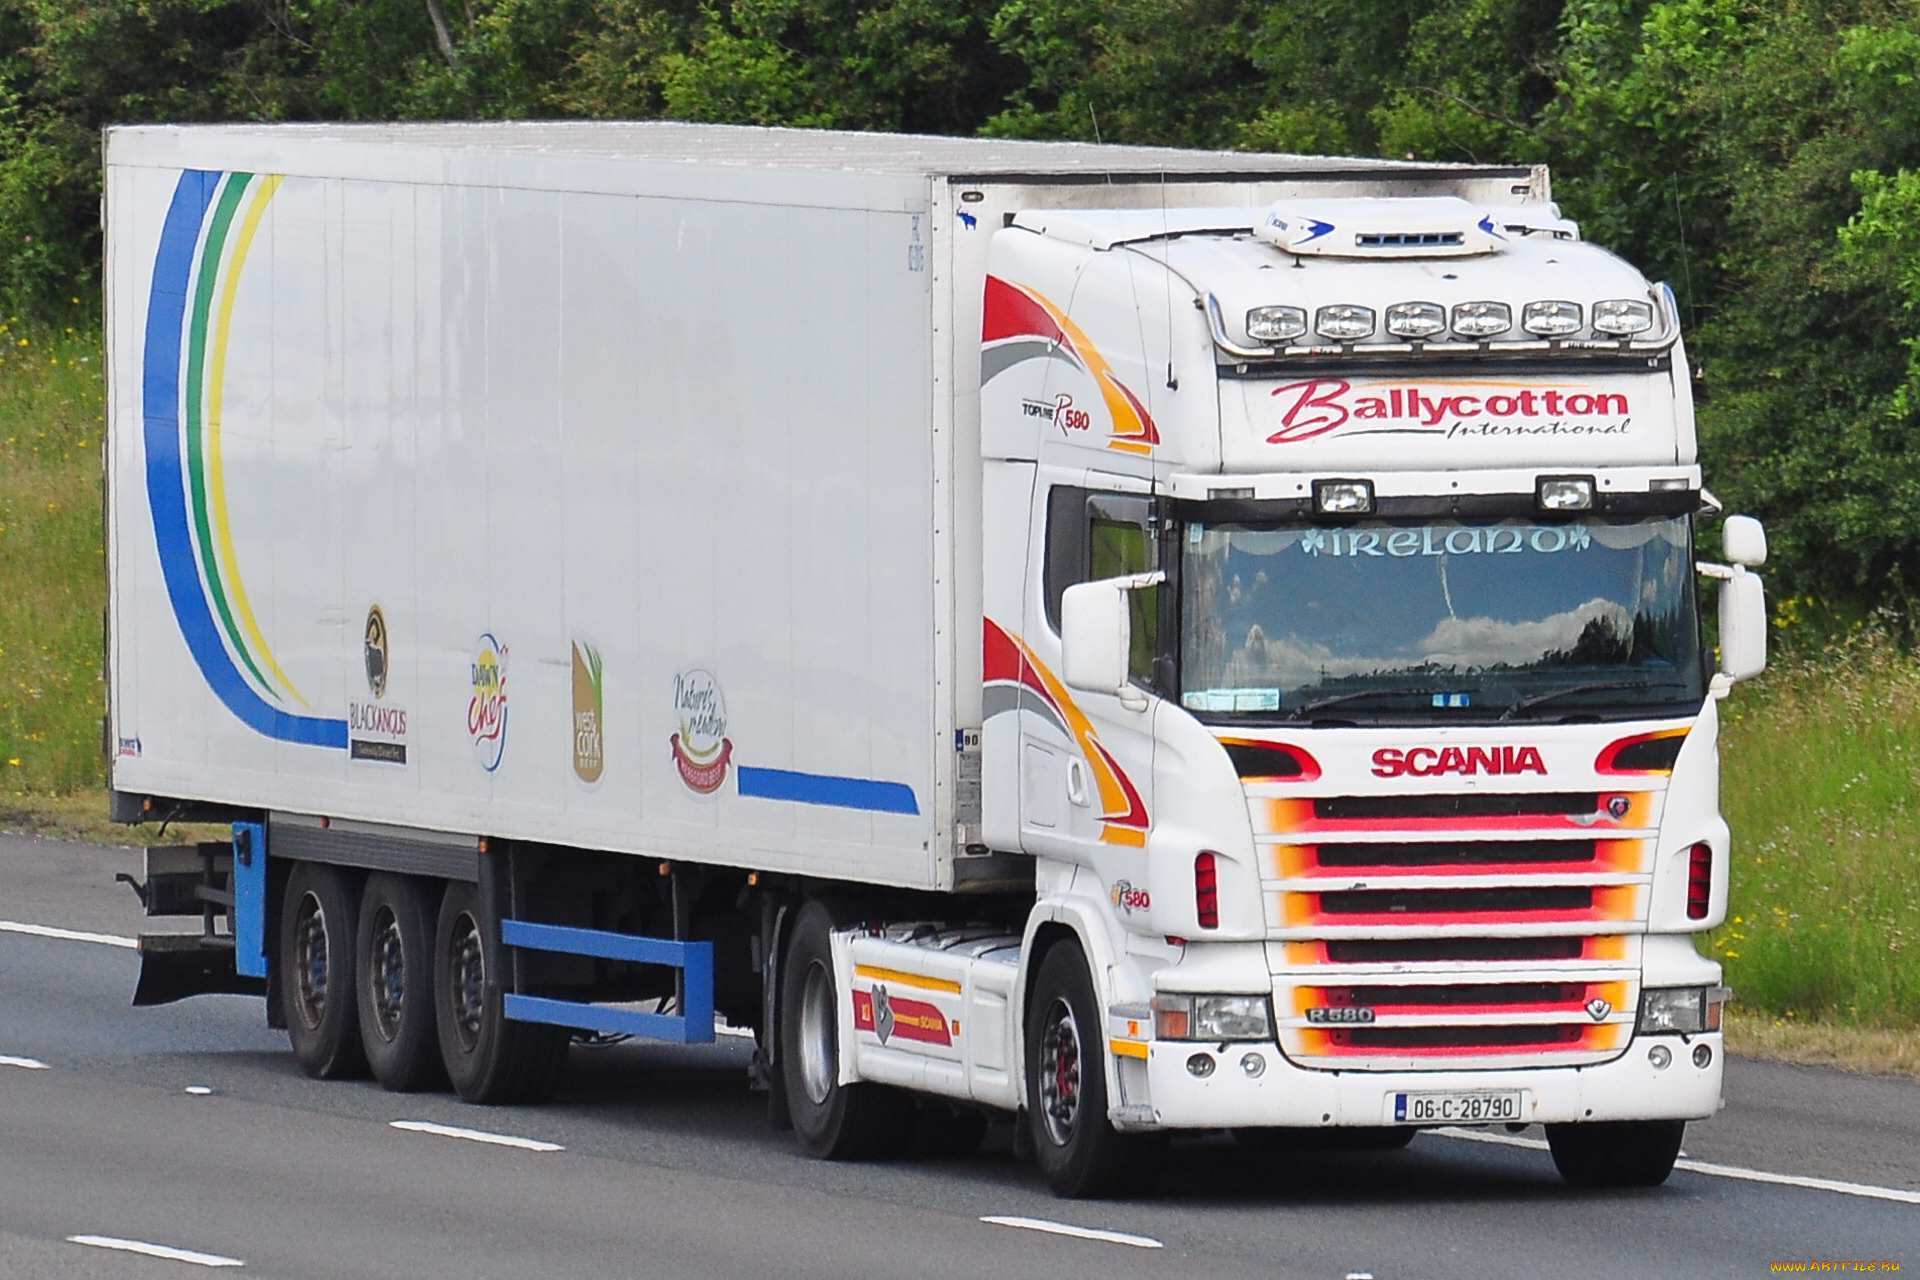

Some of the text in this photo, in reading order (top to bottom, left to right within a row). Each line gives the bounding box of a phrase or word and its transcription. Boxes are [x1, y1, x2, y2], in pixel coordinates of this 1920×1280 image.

[1265, 378, 1629, 444] Ballycotton
[1446, 417, 1631, 439] International
[1371, 746, 1548, 778] SCANIA
[1414, 1098, 1513, 1118] 06-C-28790
